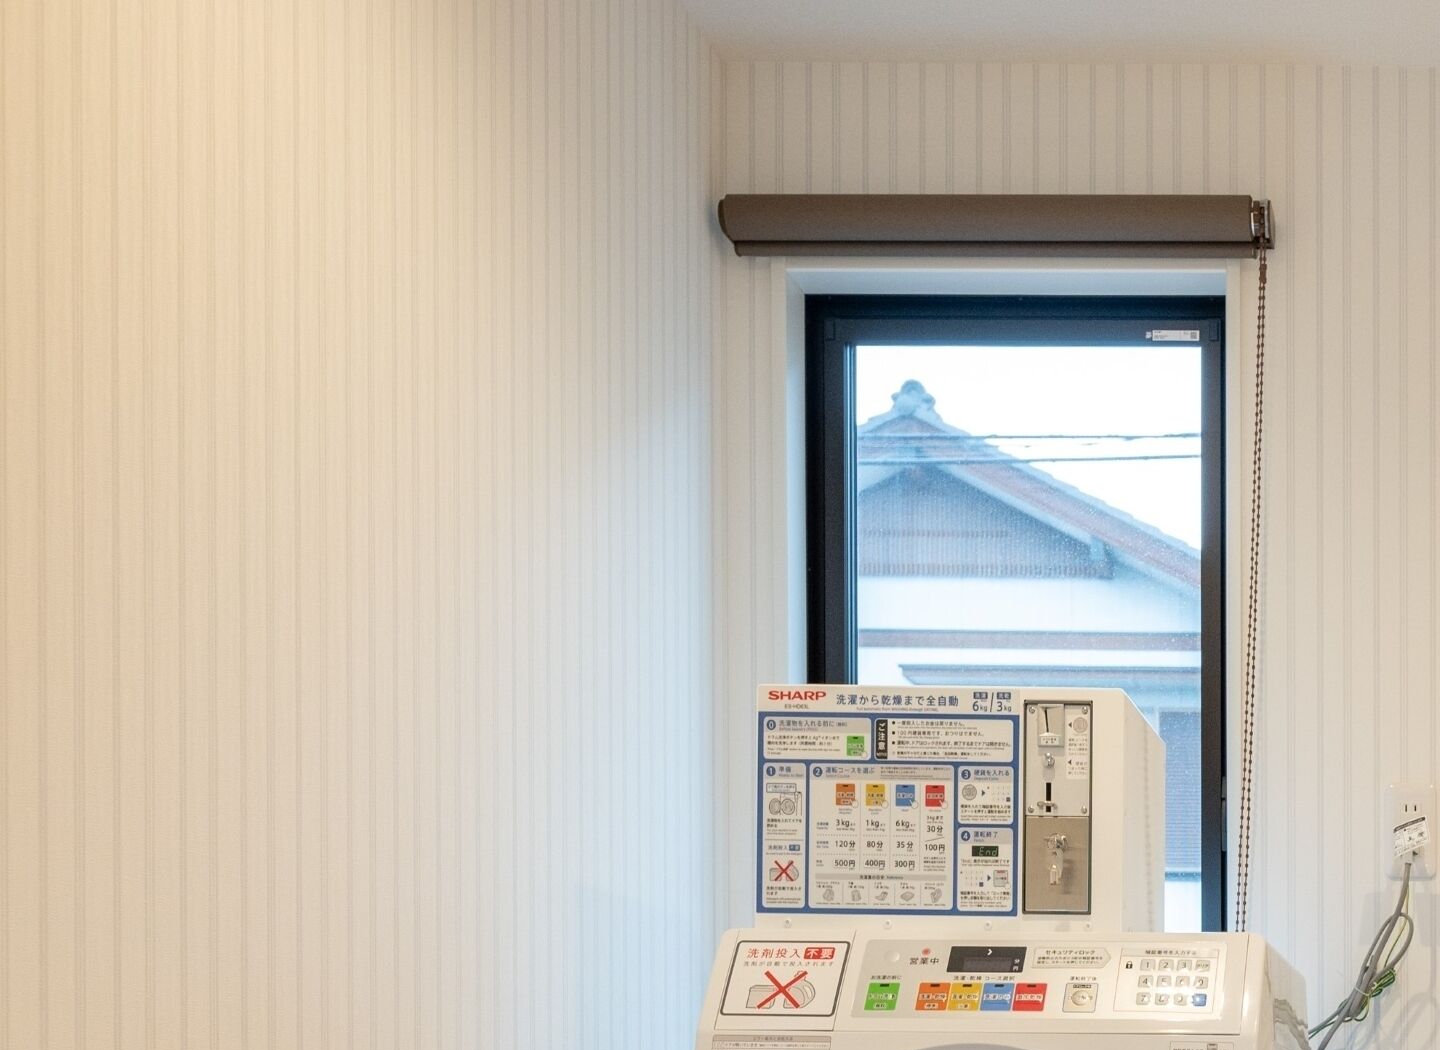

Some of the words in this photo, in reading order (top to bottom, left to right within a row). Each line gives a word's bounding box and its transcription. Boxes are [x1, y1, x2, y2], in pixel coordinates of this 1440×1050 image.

[768, 691, 827, 701] SHARP
[836, 694, 959, 707] 洗濯から乾燥まで全自動
[815, 768, 820, 776] 2
[964, 770, 968, 778] 3
[963, 832, 969, 840] 4
[835, 840, 856, 848] 120分
[896, 841, 914, 849] 35分
[924, 844, 946, 852] 100円
[978, 847, 998, 856] End
[834, 859, 856, 868] 500円
[865, 860, 886, 868] 400円
[894, 860, 916, 868] 300円
[747, 948, 800, 958] 洗剤投入
[806, 948, 834, 958] 不要
[909, 957, 940, 966] 営業中
